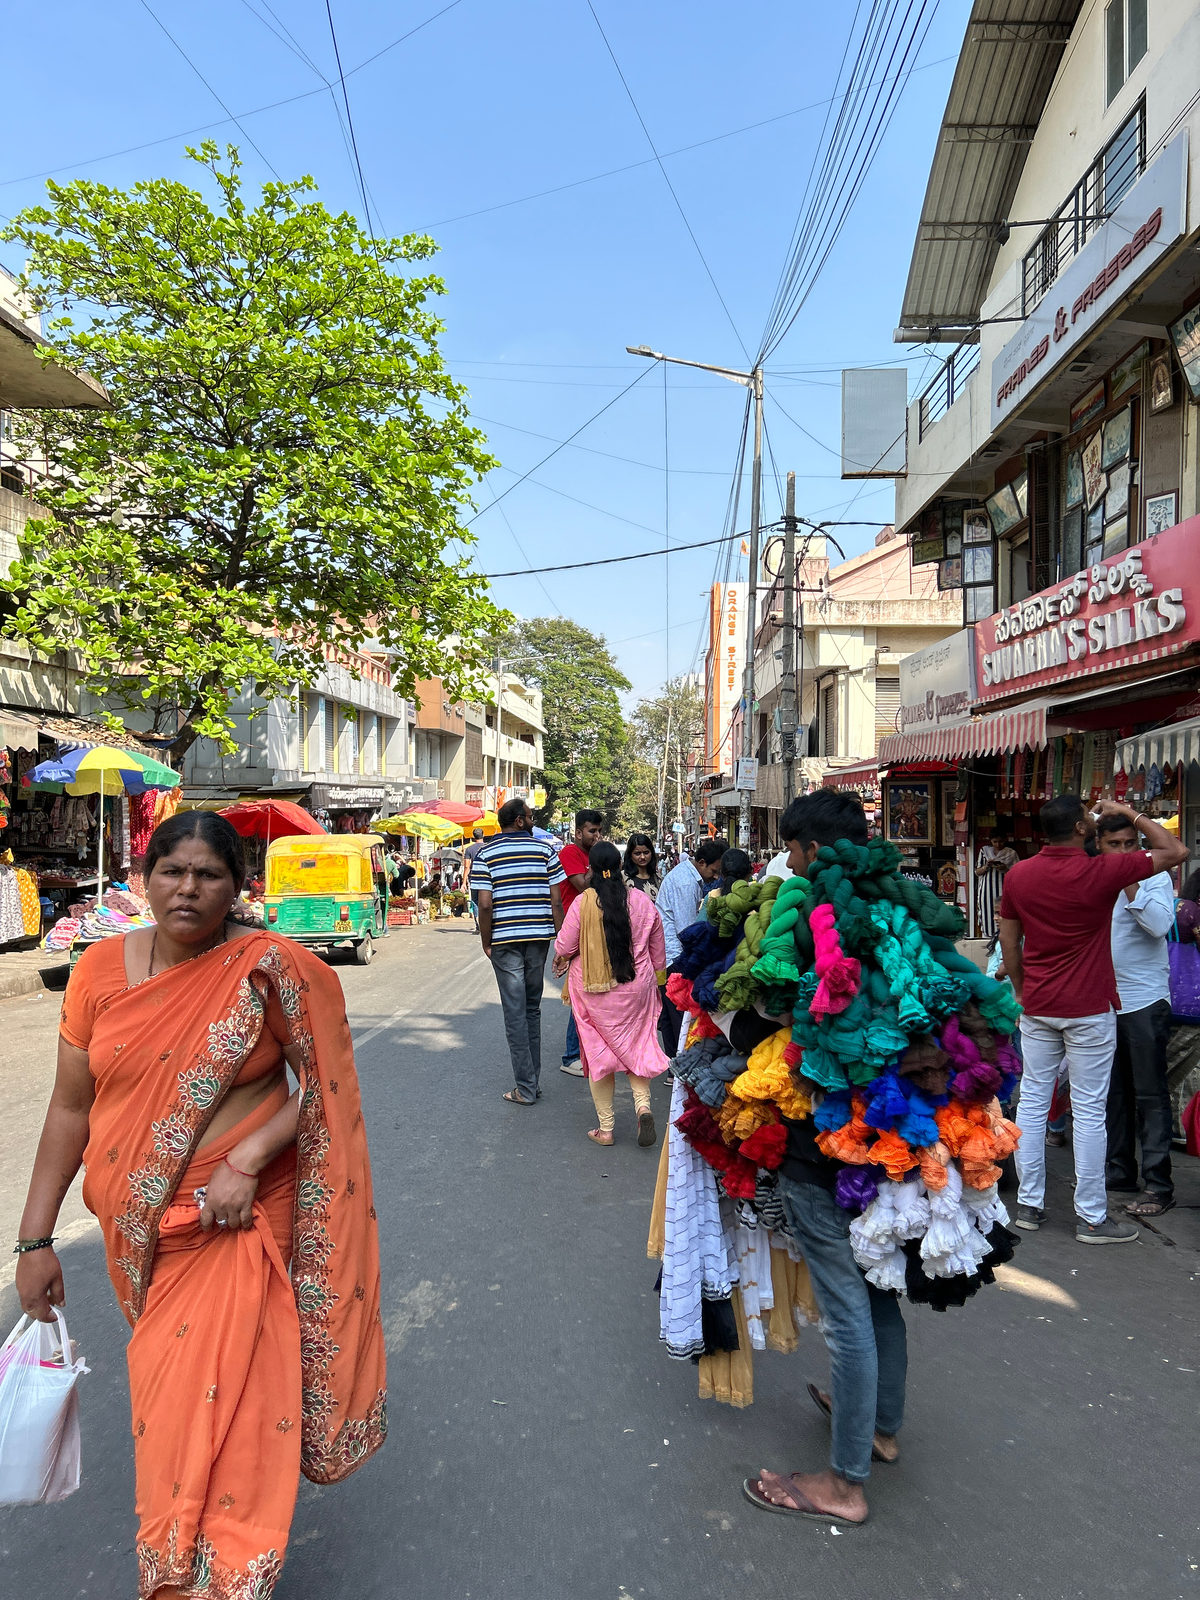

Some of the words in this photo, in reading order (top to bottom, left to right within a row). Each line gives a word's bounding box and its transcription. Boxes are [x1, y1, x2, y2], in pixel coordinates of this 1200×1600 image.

[996, 334, 1050, 408] FRAMES
[1053, 307, 1069, 343] &
[727, 590, 737, 636] ORANGE
[982, 618, 1088, 687] SUVARNA'S
[1088, 588, 1186, 655] SILKS
[993, 571, 1089, 645] ಸುವರ್ಣಾಸ್
[727, 647, 737, 691] STREET
